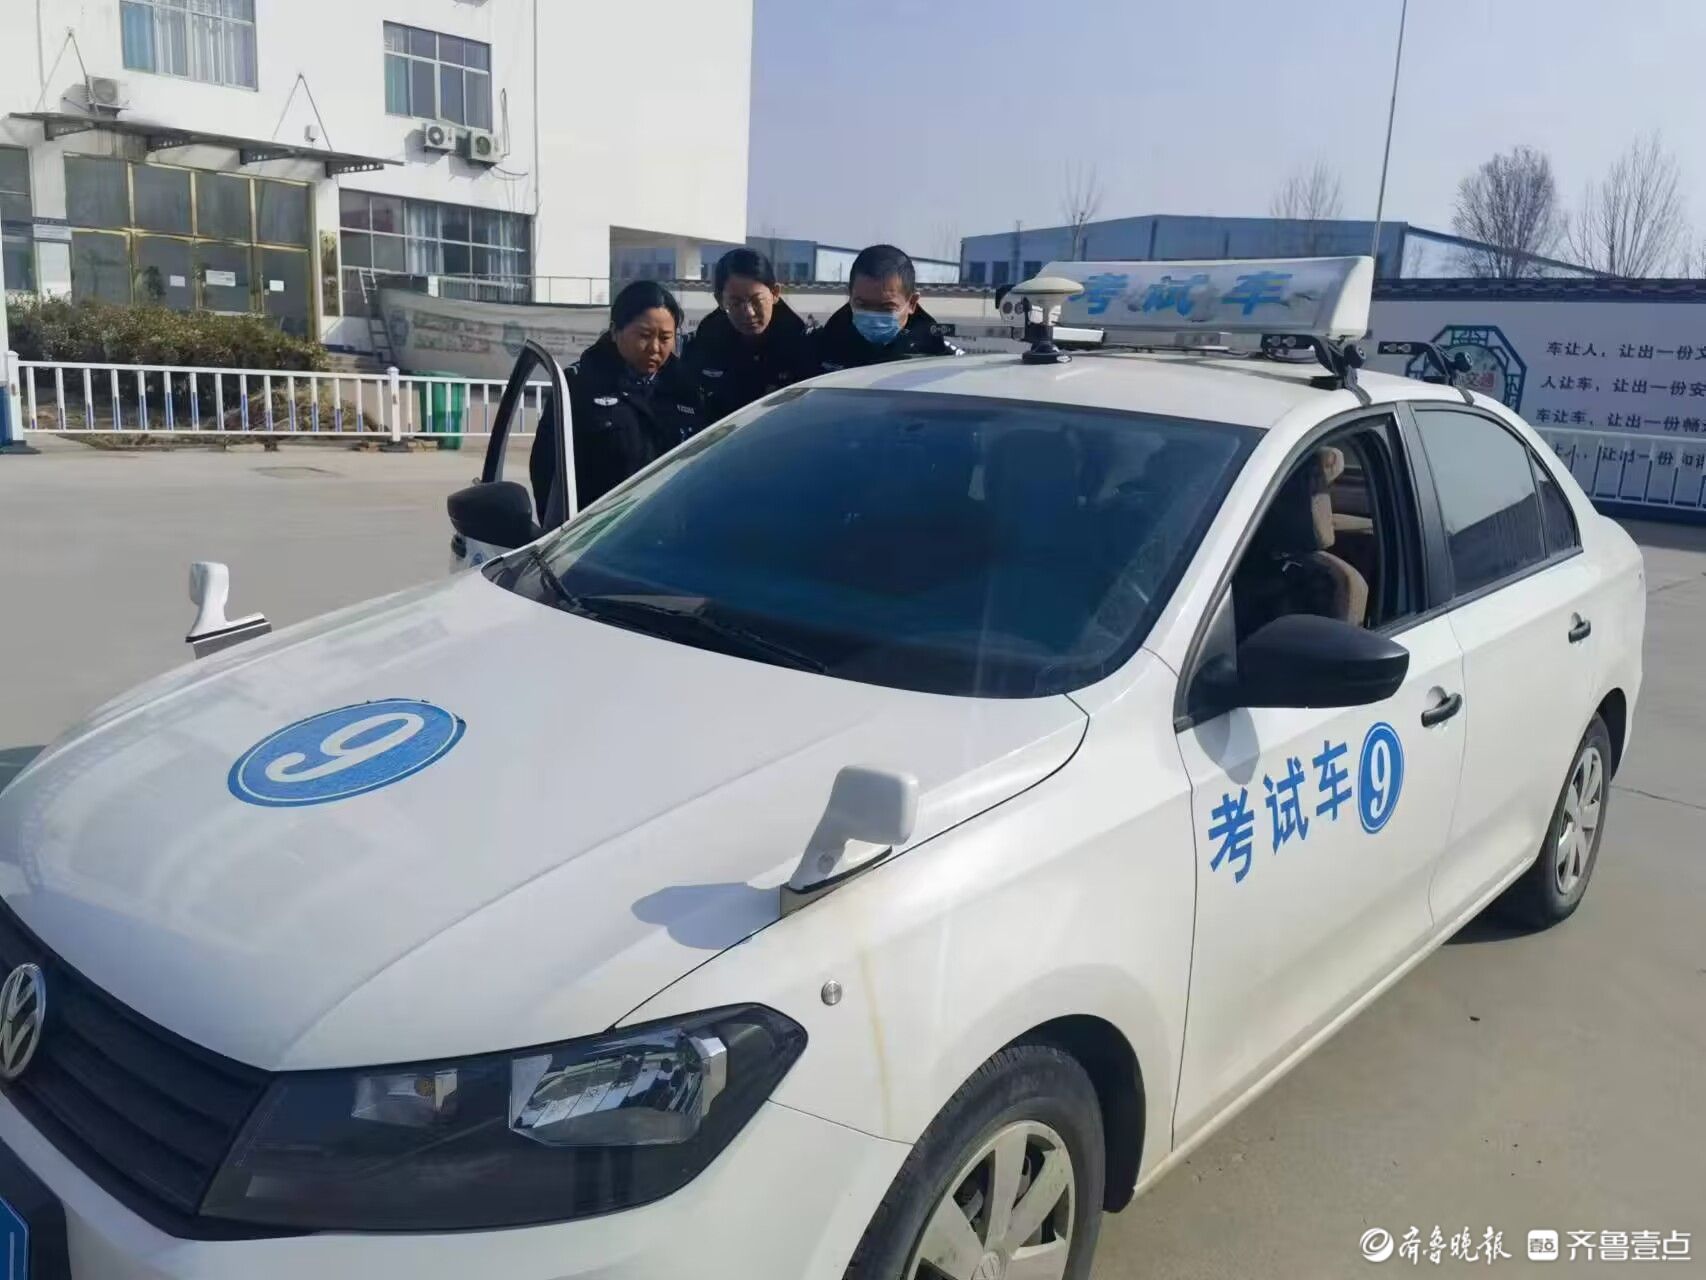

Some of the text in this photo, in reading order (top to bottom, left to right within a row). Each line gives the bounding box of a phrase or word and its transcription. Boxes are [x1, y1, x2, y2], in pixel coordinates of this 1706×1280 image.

[264, 712, 425, 783] 9
[1208, 739, 1392, 884] 考试车 9
